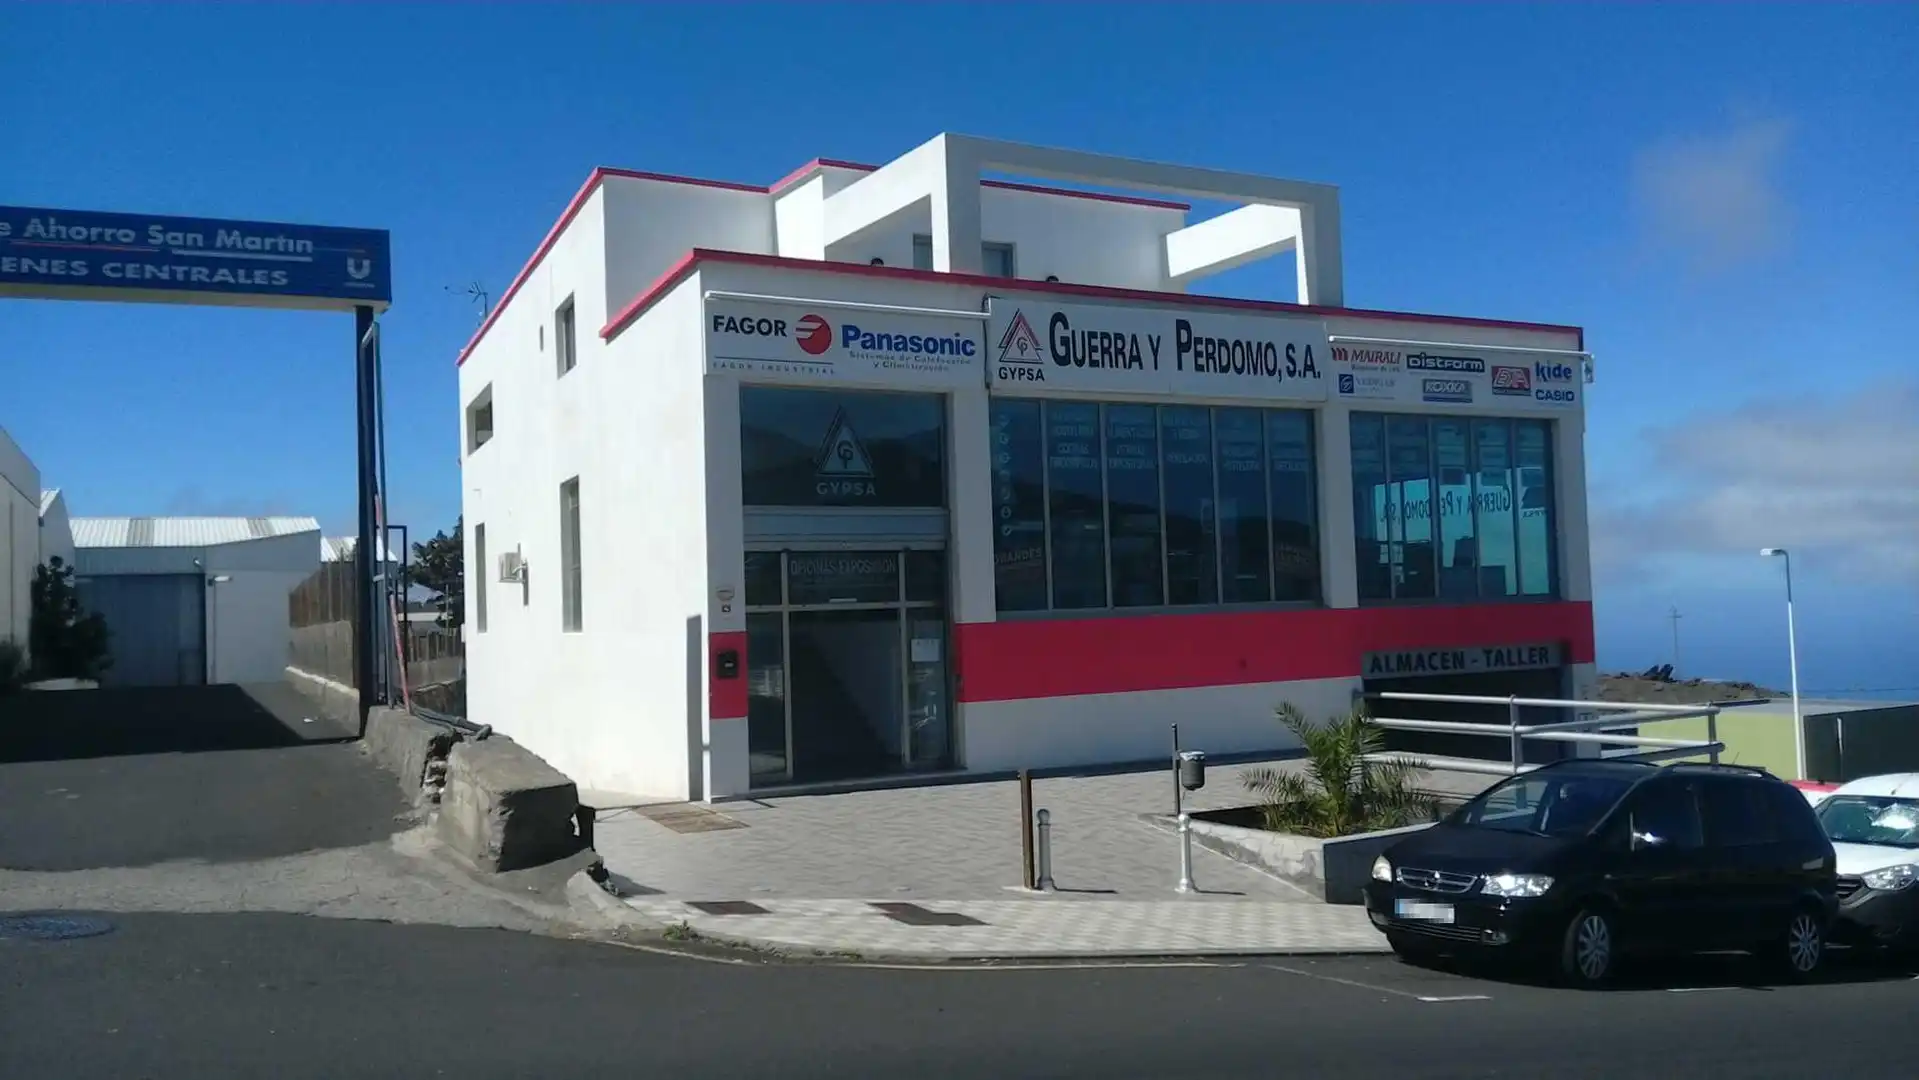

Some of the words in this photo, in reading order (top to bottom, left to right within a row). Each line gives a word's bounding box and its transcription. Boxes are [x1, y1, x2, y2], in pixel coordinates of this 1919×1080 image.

[23, 217, 136, 243] Ahorro
[148, 225, 203, 247] San
[102, 261, 288, 285] CENTRALES
[713, 314, 787, 337] FAGOR
[842, 325, 976, 356] Panasonic
[1050, 312, 1143, 371] GUERRA
[1147, 333, 1161, 372] Y
[998, 367, 1045, 382] GYPSA
[1535, 388, 1575, 402] CASIO
[815, 480, 877, 496] GYPSA
[1370, 650, 1465, 674] ALMACEN
[1484, 646, 1549, 668] TALLER
